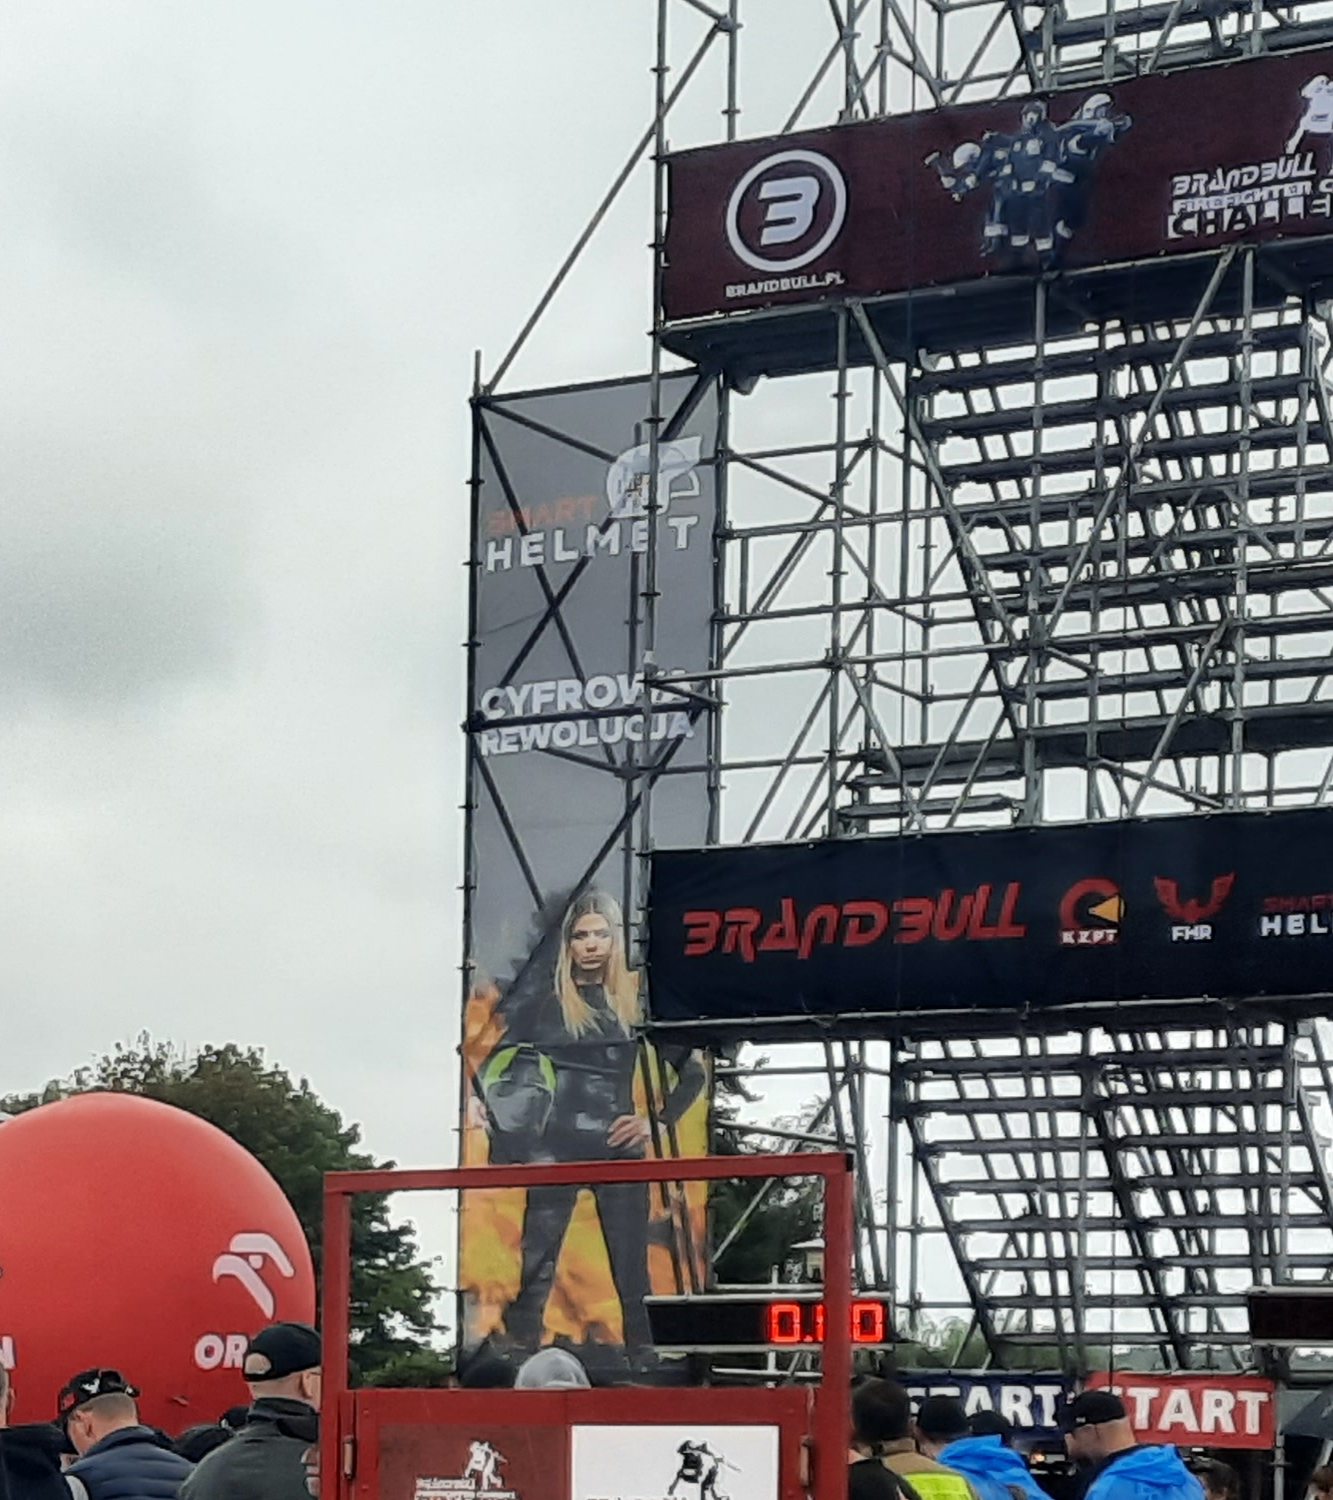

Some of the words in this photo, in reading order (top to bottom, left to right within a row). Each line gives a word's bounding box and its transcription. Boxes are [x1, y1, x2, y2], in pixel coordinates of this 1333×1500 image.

[725, 271, 845, 298] BRANDBULL.PL
[485, 515, 699, 572] HELMET
[480, 712, 695, 757] REWOLUCJA
[1061, 928, 1118, 945] KZPT
[1171, 924, 1213, 943] FHR
